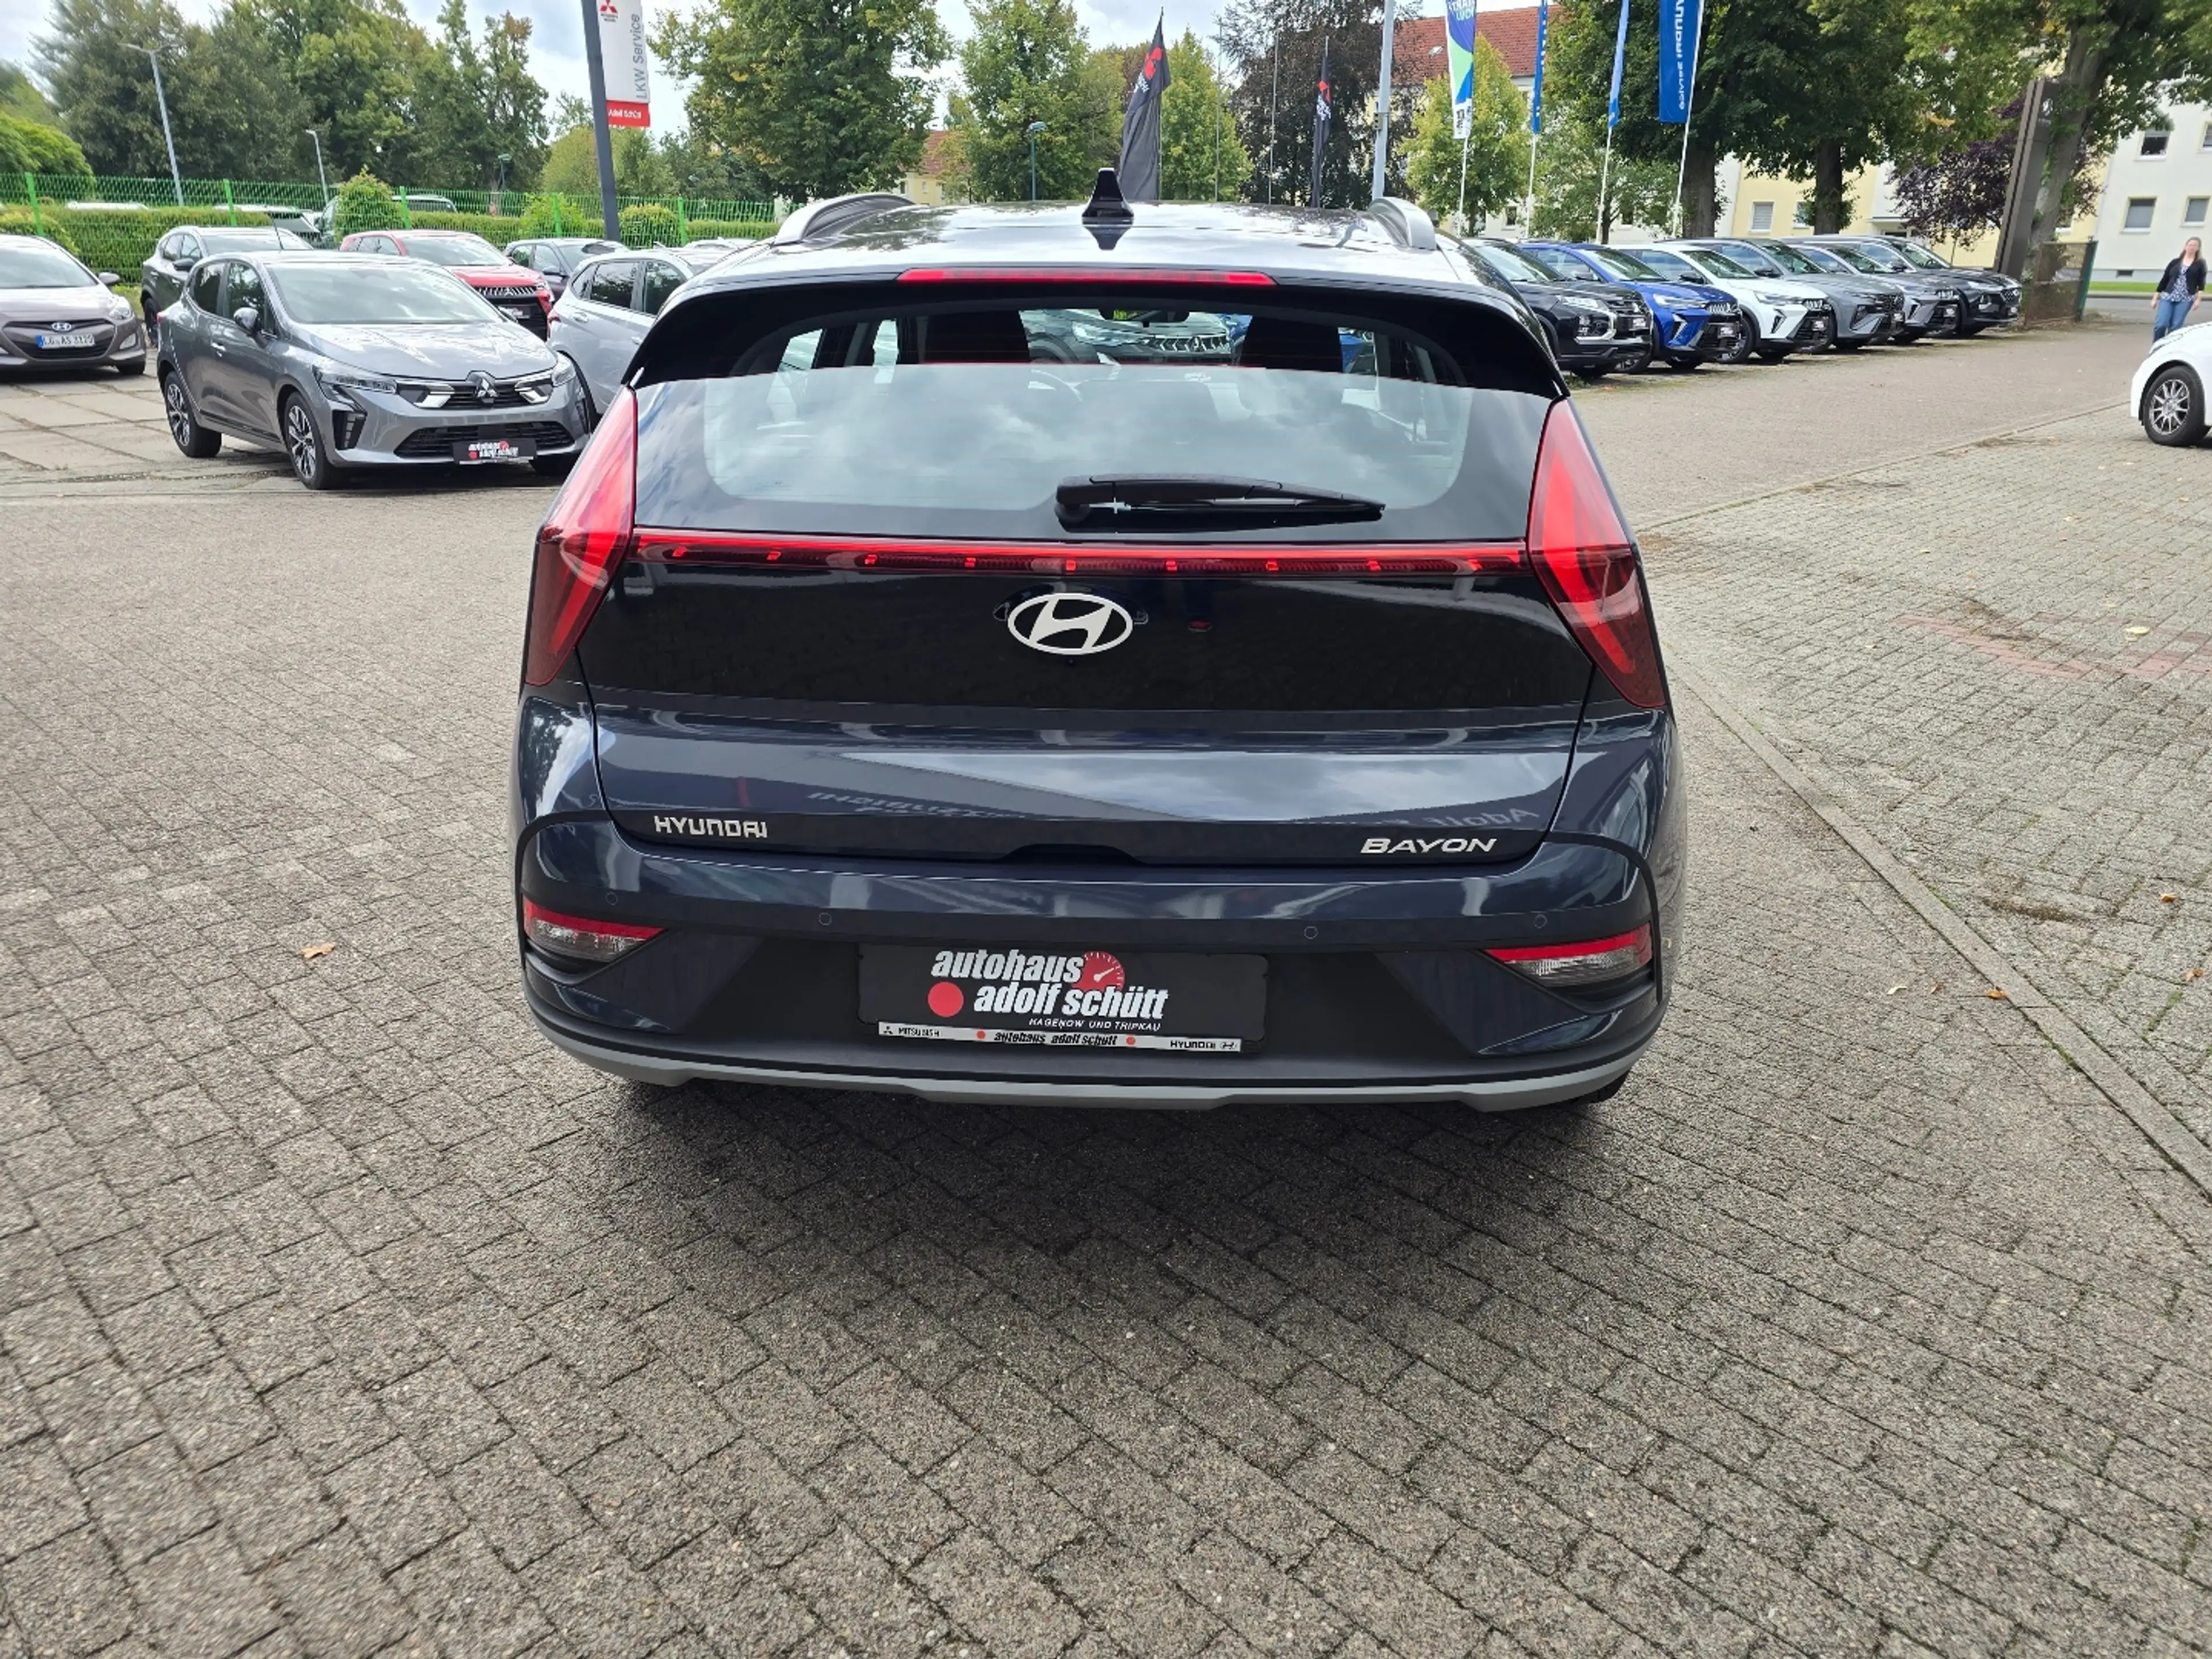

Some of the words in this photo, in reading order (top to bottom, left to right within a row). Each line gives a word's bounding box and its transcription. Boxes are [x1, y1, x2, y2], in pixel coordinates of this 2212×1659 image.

[630, 14, 645, 63] Service
[633, 68, 647, 99] LKW
[654, 815, 768, 838] HYUNDAI
[1359, 838, 1497, 854] BAYON
[931, 949, 1084, 983] autohaus
[974, 982, 1060, 1014] adolf
[1061, 986, 1169, 1020] schütt
[1028, 1018, 1085, 1029] HAGENOW
[1088, 1020, 1112, 1029] UND
[1114, 1021, 1161, 1032] TRIPKAU
[994, 1032, 1046, 1044] autohaus
[1050, 1033, 1081, 1045] adolf
[1170, 1040, 1216, 1050] HYUNDAI
